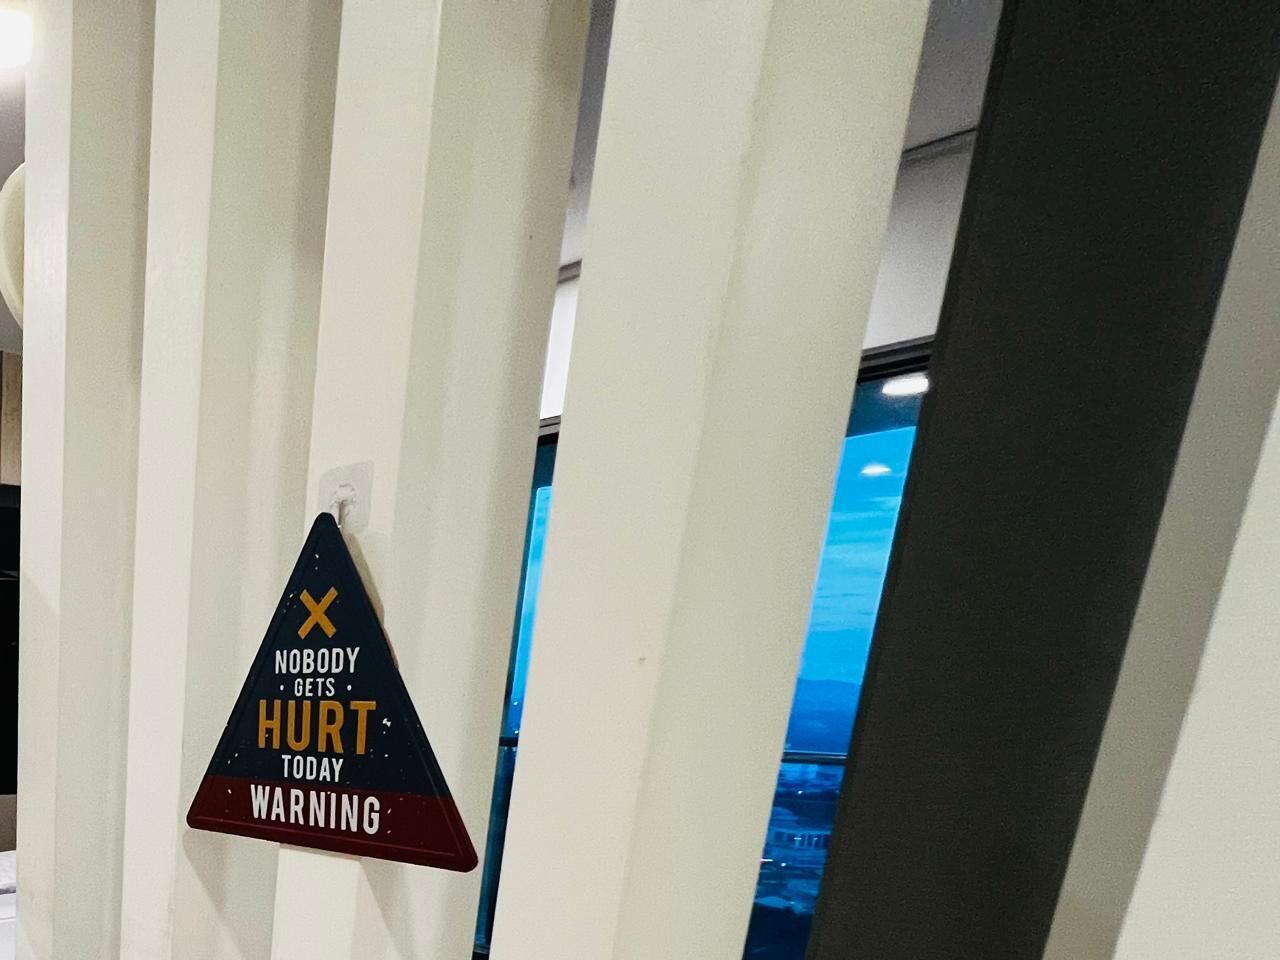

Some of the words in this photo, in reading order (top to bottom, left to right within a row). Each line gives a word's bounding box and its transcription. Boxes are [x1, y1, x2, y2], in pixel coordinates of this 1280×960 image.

[274, 646, 360, 675] NOBODY
[294, 677, 336, 697] GETS
[257, 699, 377, 755] HURT
[281, 754, 344, 783] TODAY
[250, 784, 381, 835] WARNING
